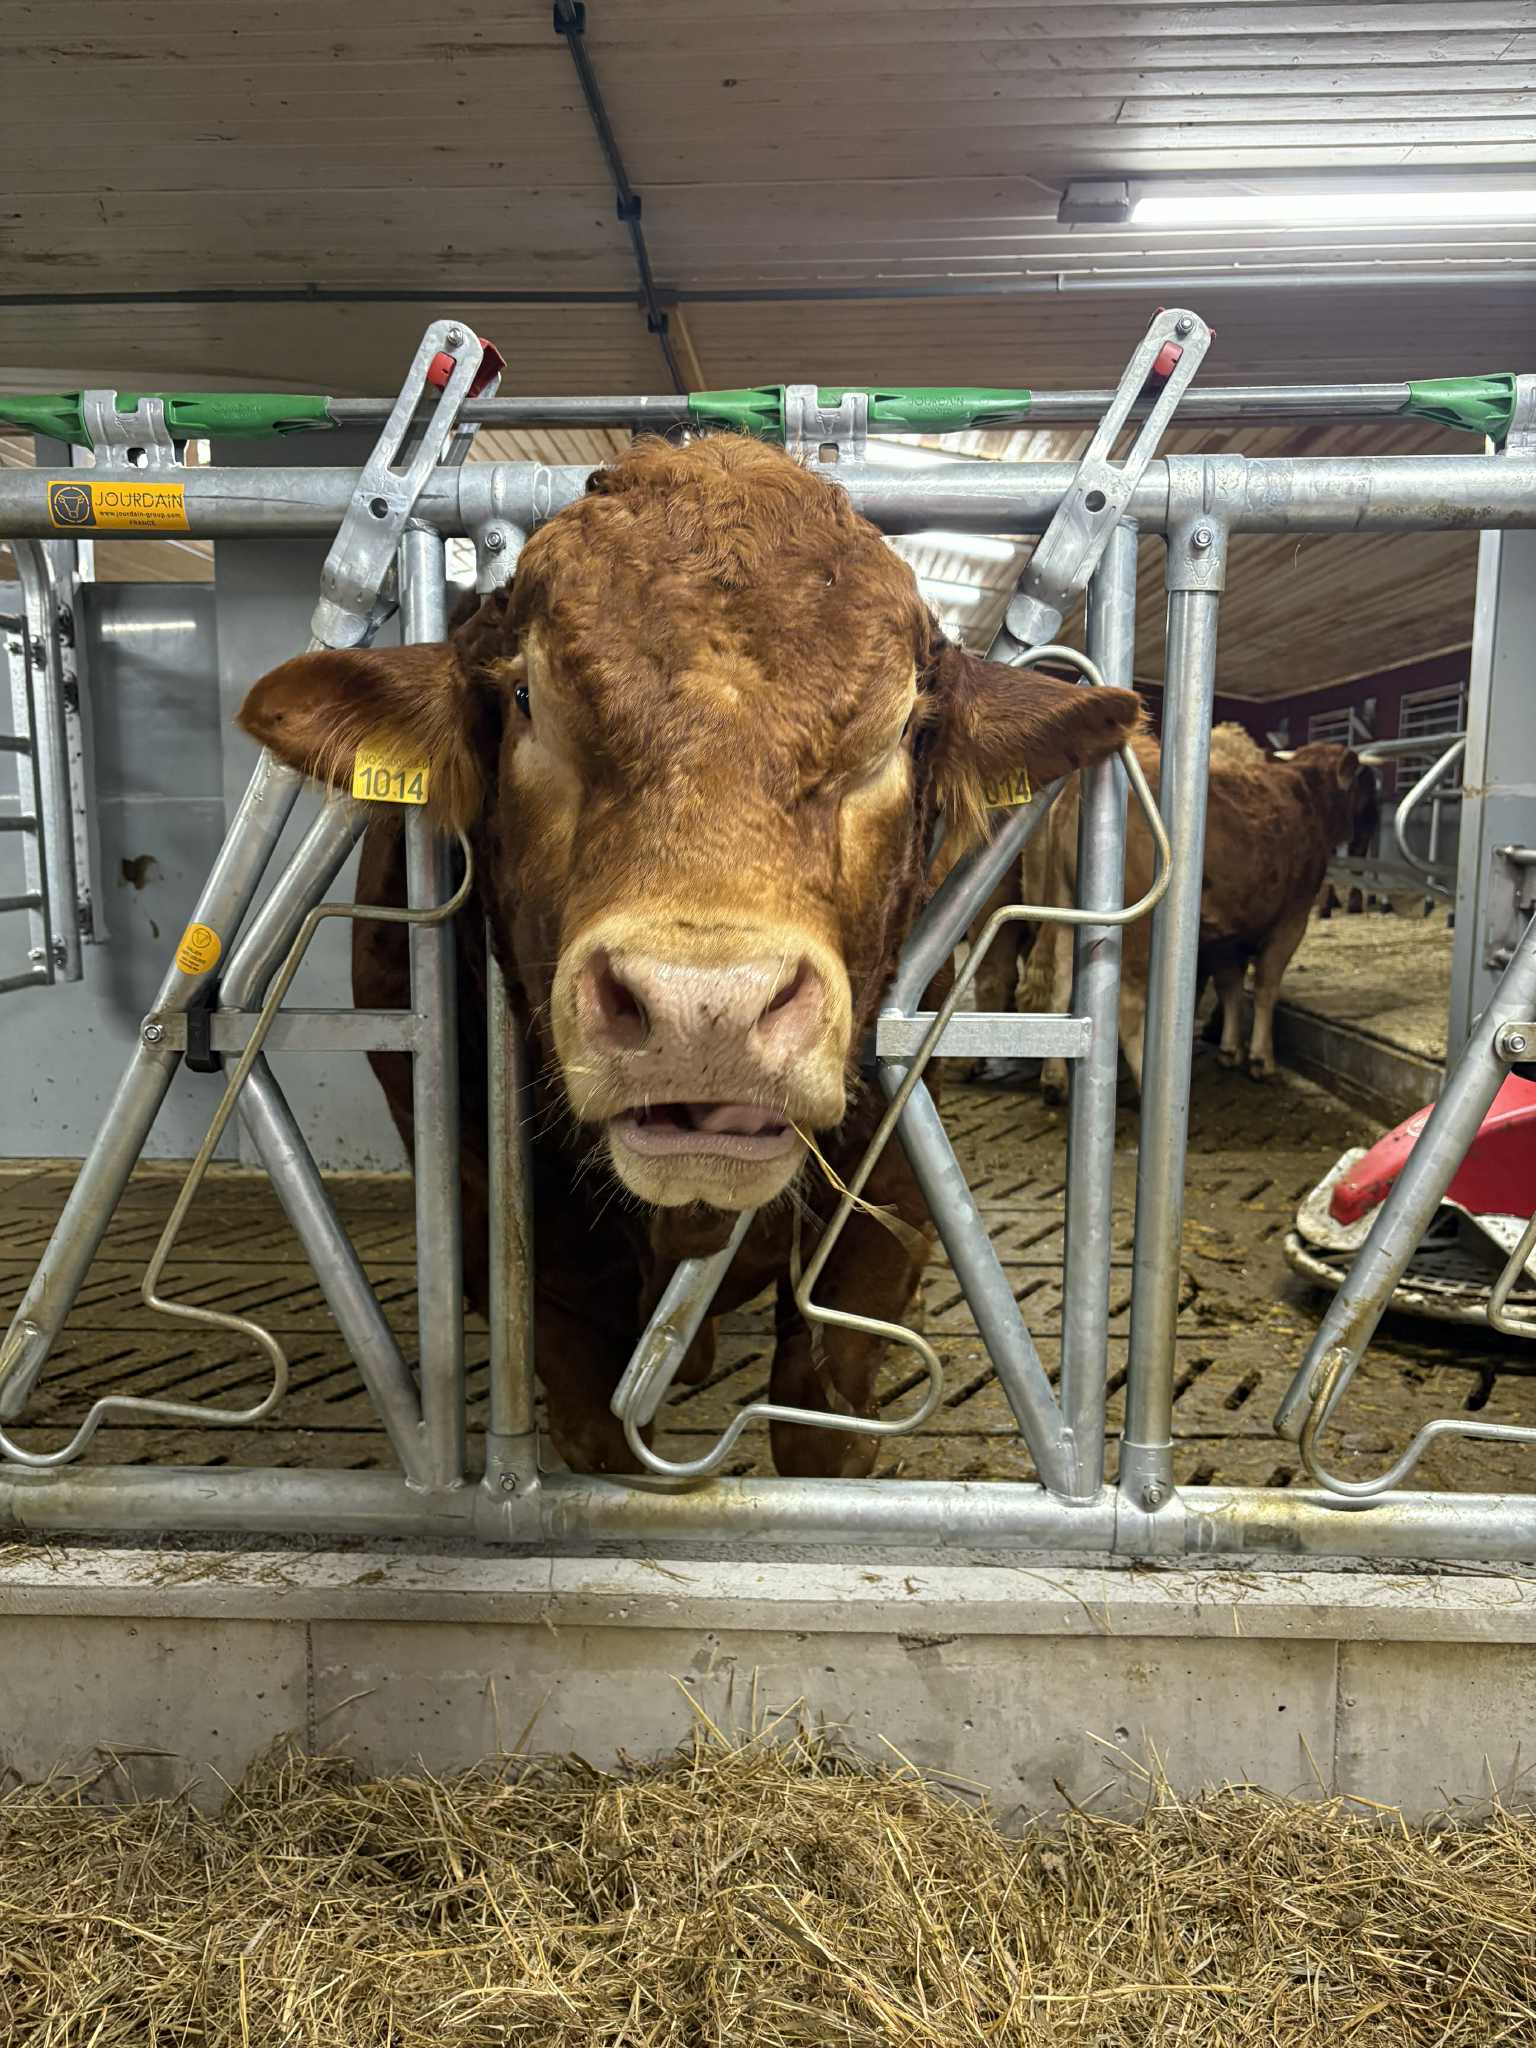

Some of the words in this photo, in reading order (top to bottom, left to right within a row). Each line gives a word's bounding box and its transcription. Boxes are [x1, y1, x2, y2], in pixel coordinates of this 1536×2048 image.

[99, 510, 181, 520] www.jourdain-group.com
[360, 767, 424, 800] 1014
[984, 770, 1028, 805] 014
